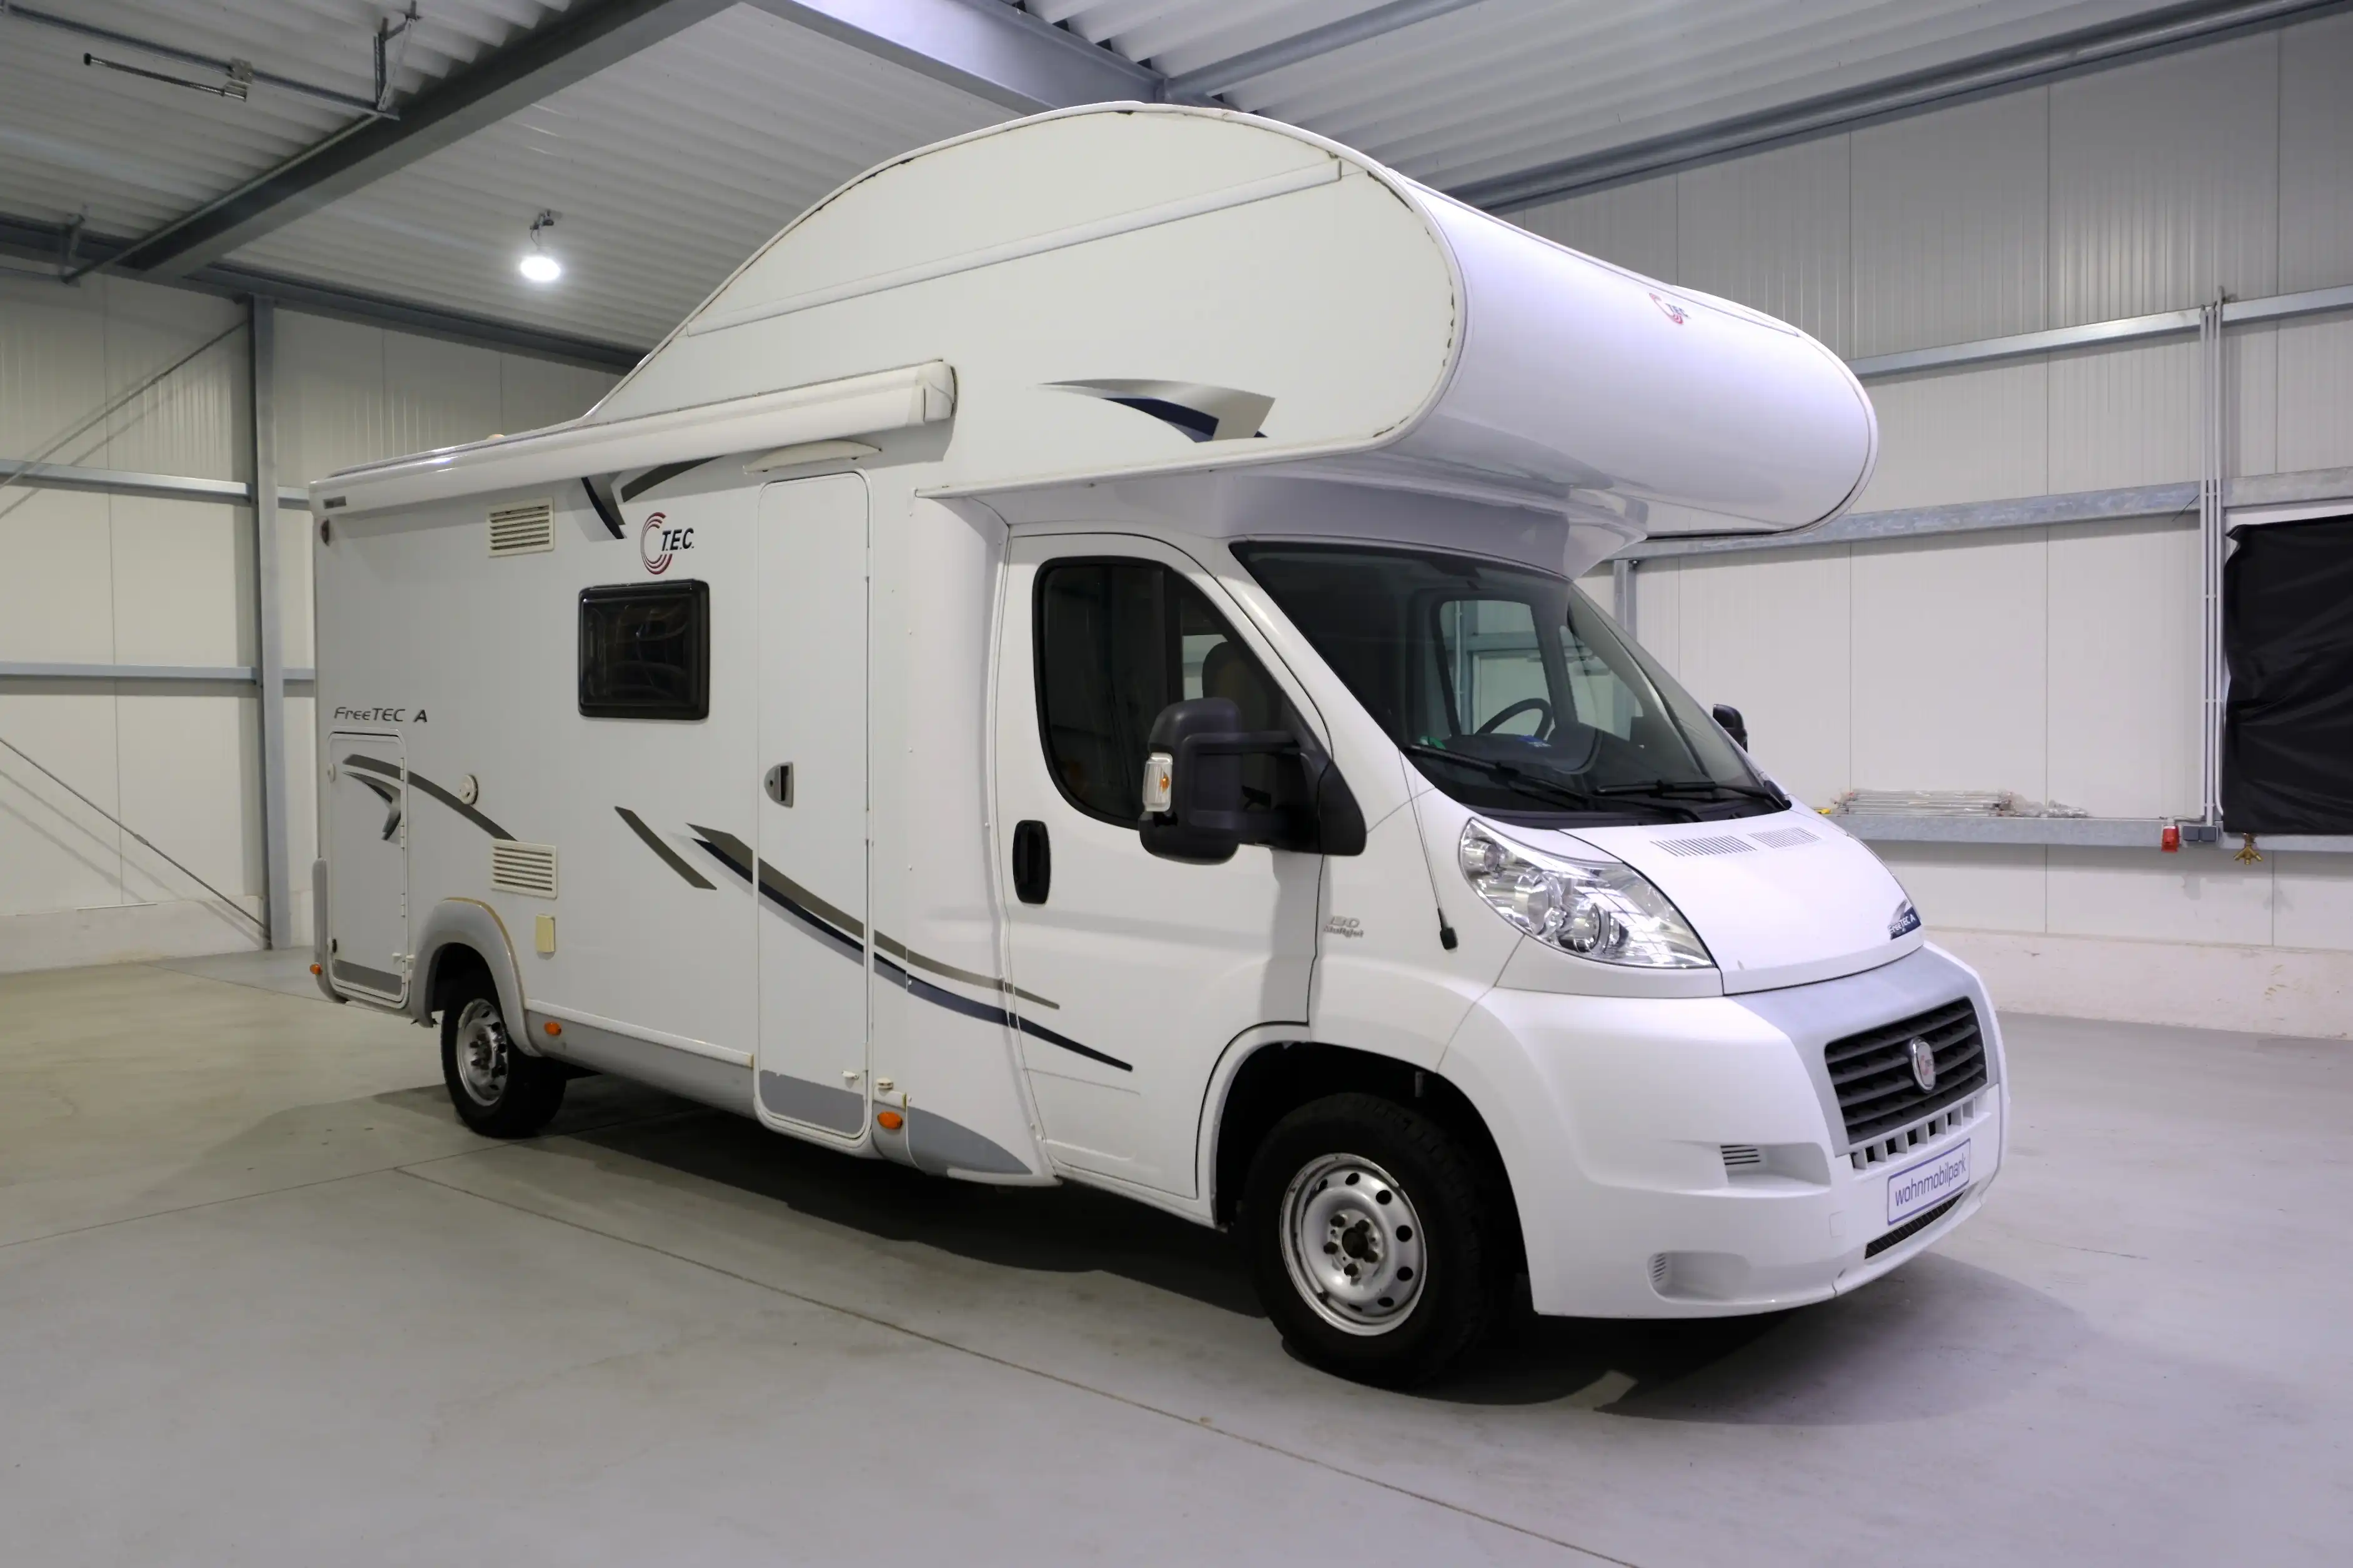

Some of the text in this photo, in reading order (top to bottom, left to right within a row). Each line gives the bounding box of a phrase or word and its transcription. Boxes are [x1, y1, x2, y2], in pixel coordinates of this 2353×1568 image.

[334, 706, 428, 723] FreeTEC A
[1895, 1153, 1966, 1206] wohnmobilpark
